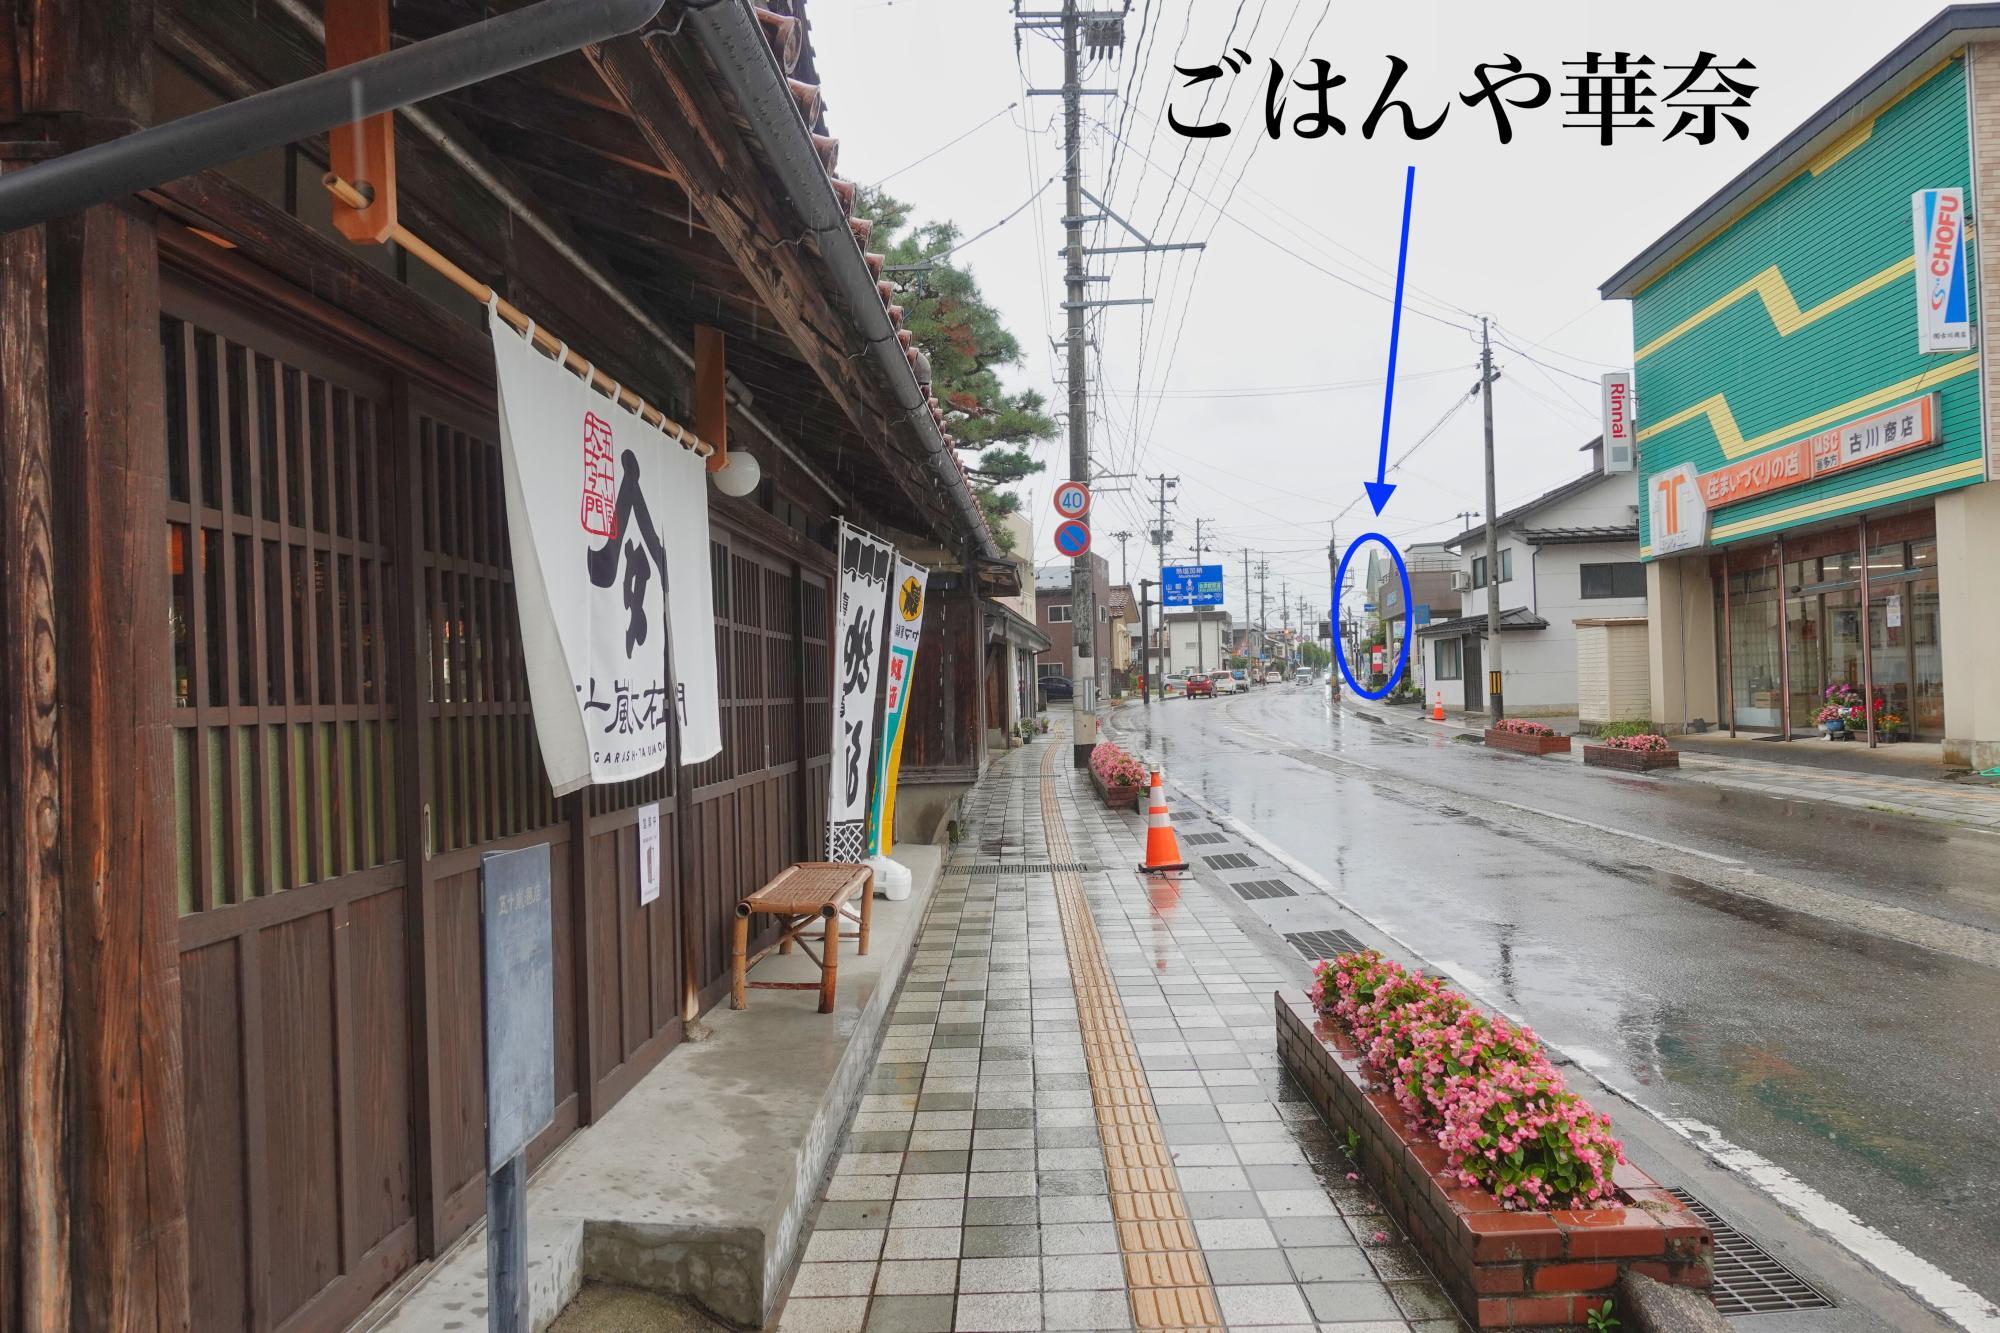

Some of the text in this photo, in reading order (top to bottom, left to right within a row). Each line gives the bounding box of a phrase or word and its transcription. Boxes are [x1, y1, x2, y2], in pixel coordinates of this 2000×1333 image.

[1931, 196, 1958, 276] CHOFU
[1610, 383, 1627, 439] Rinnai
[1849, 415, 1915, 455] 古川商店
[1706, 451, 1800, 500] 住まいづくりの店
[1062, 492, 1082, 509] 40
